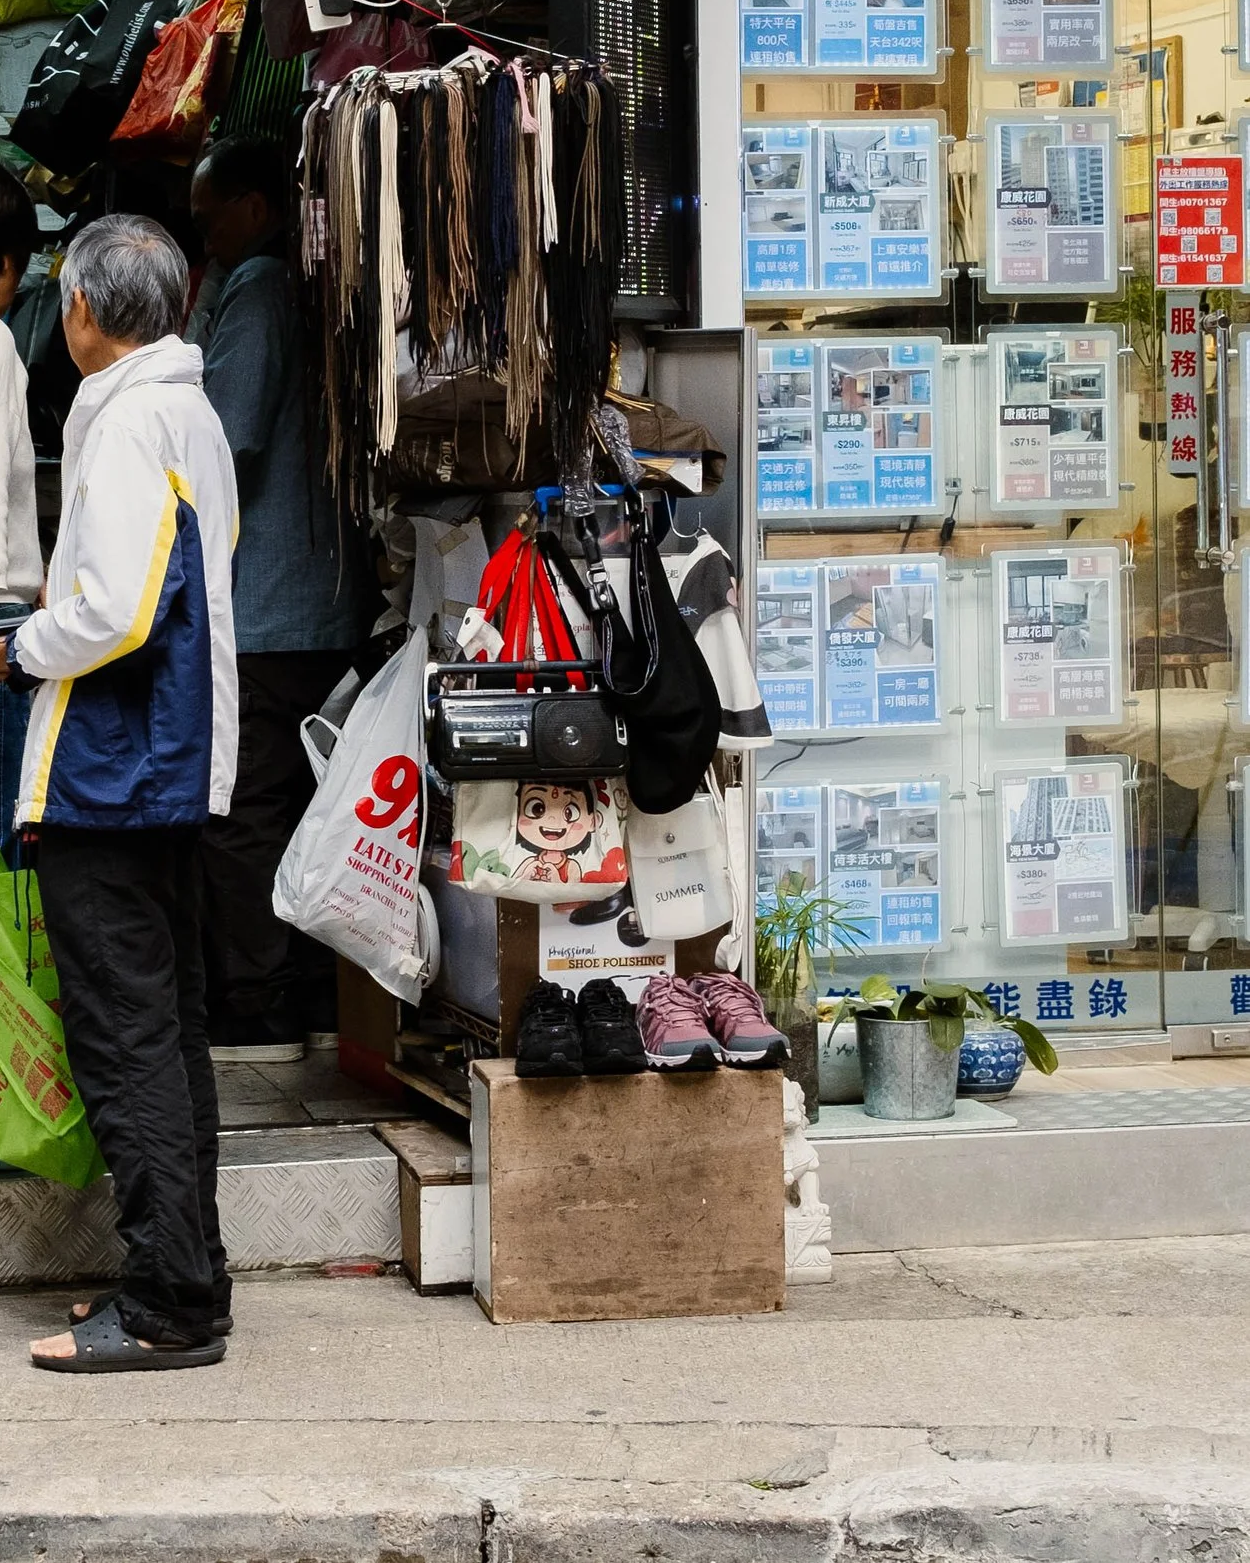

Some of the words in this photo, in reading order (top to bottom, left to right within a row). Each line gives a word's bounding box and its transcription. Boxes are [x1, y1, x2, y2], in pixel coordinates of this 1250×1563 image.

[1170, 307, 1197, 463] 服務熱線
[352, 836, 417, 883] LATEST
[654, 882, 706, 903] SUMMER
[568, 959, 600, 969] SHOE
[603, 955, 666, 968] POLISHING
